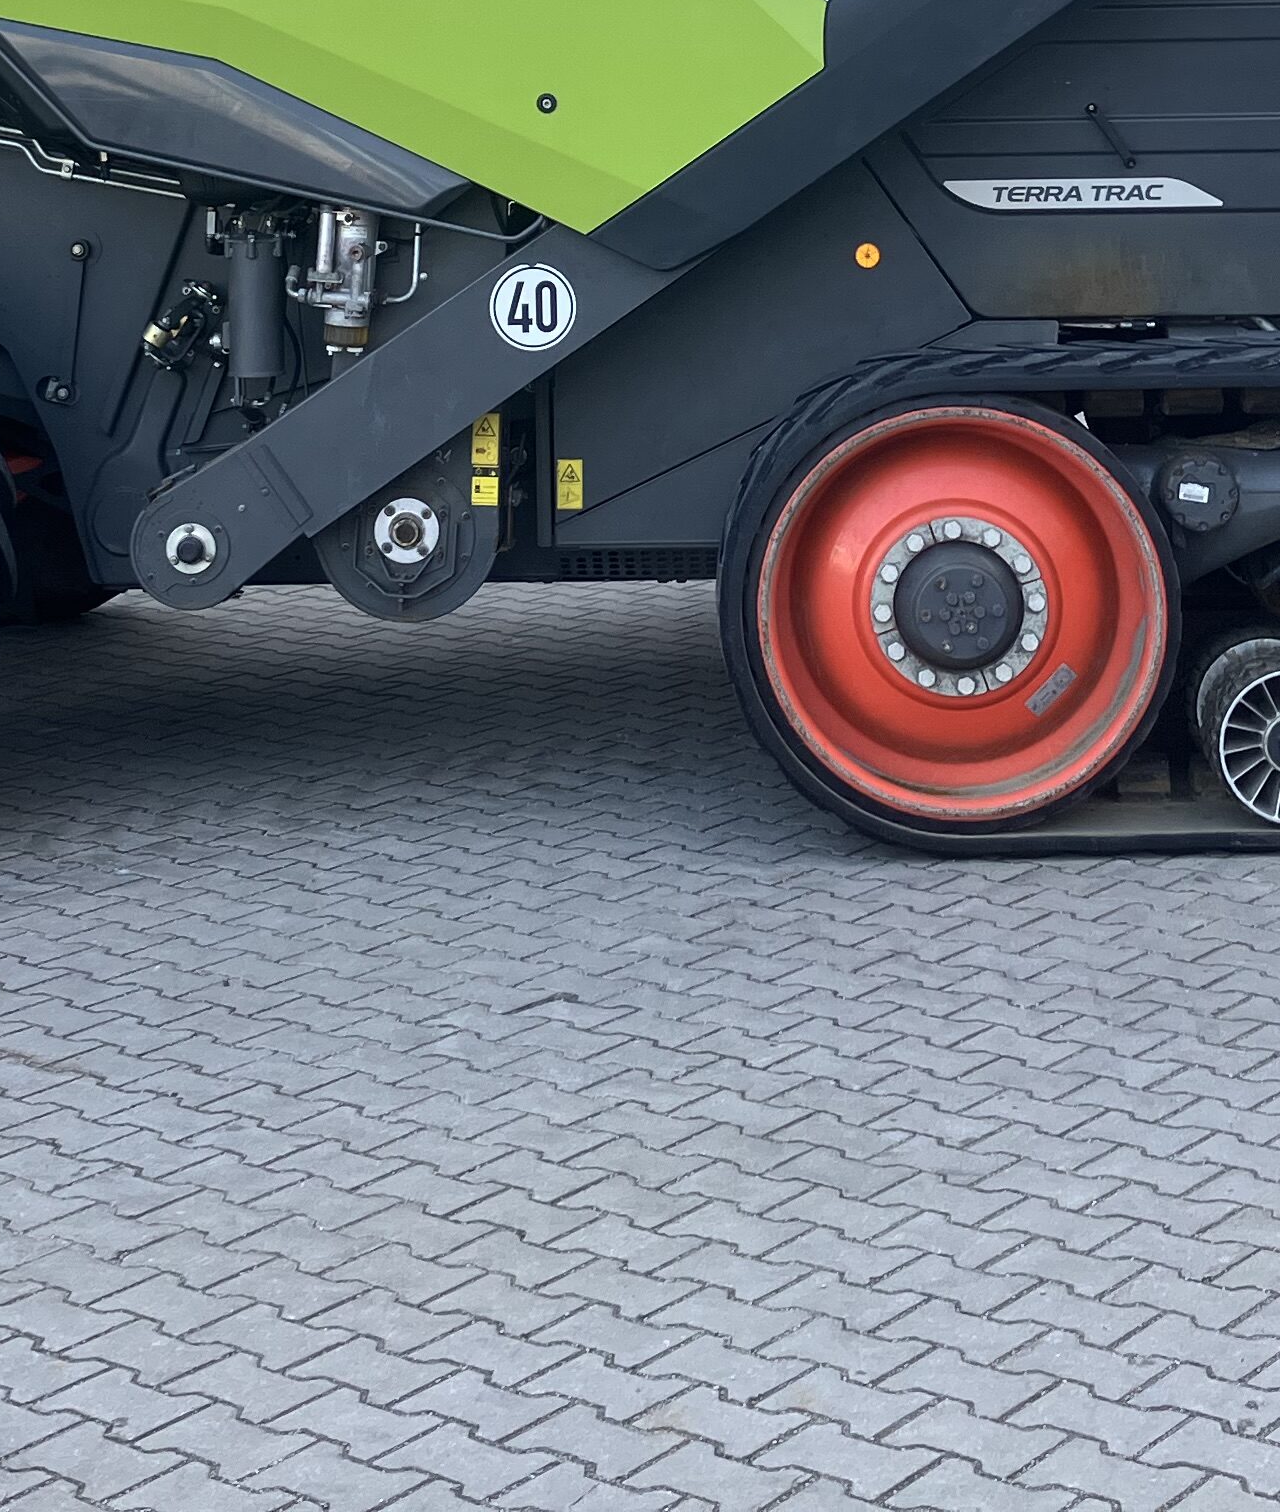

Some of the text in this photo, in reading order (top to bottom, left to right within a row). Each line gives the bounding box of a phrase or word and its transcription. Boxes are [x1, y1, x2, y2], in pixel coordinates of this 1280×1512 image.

[992, 184, 1164, 203] TERRA TRAC
[507, 280, 558, 333] 40
